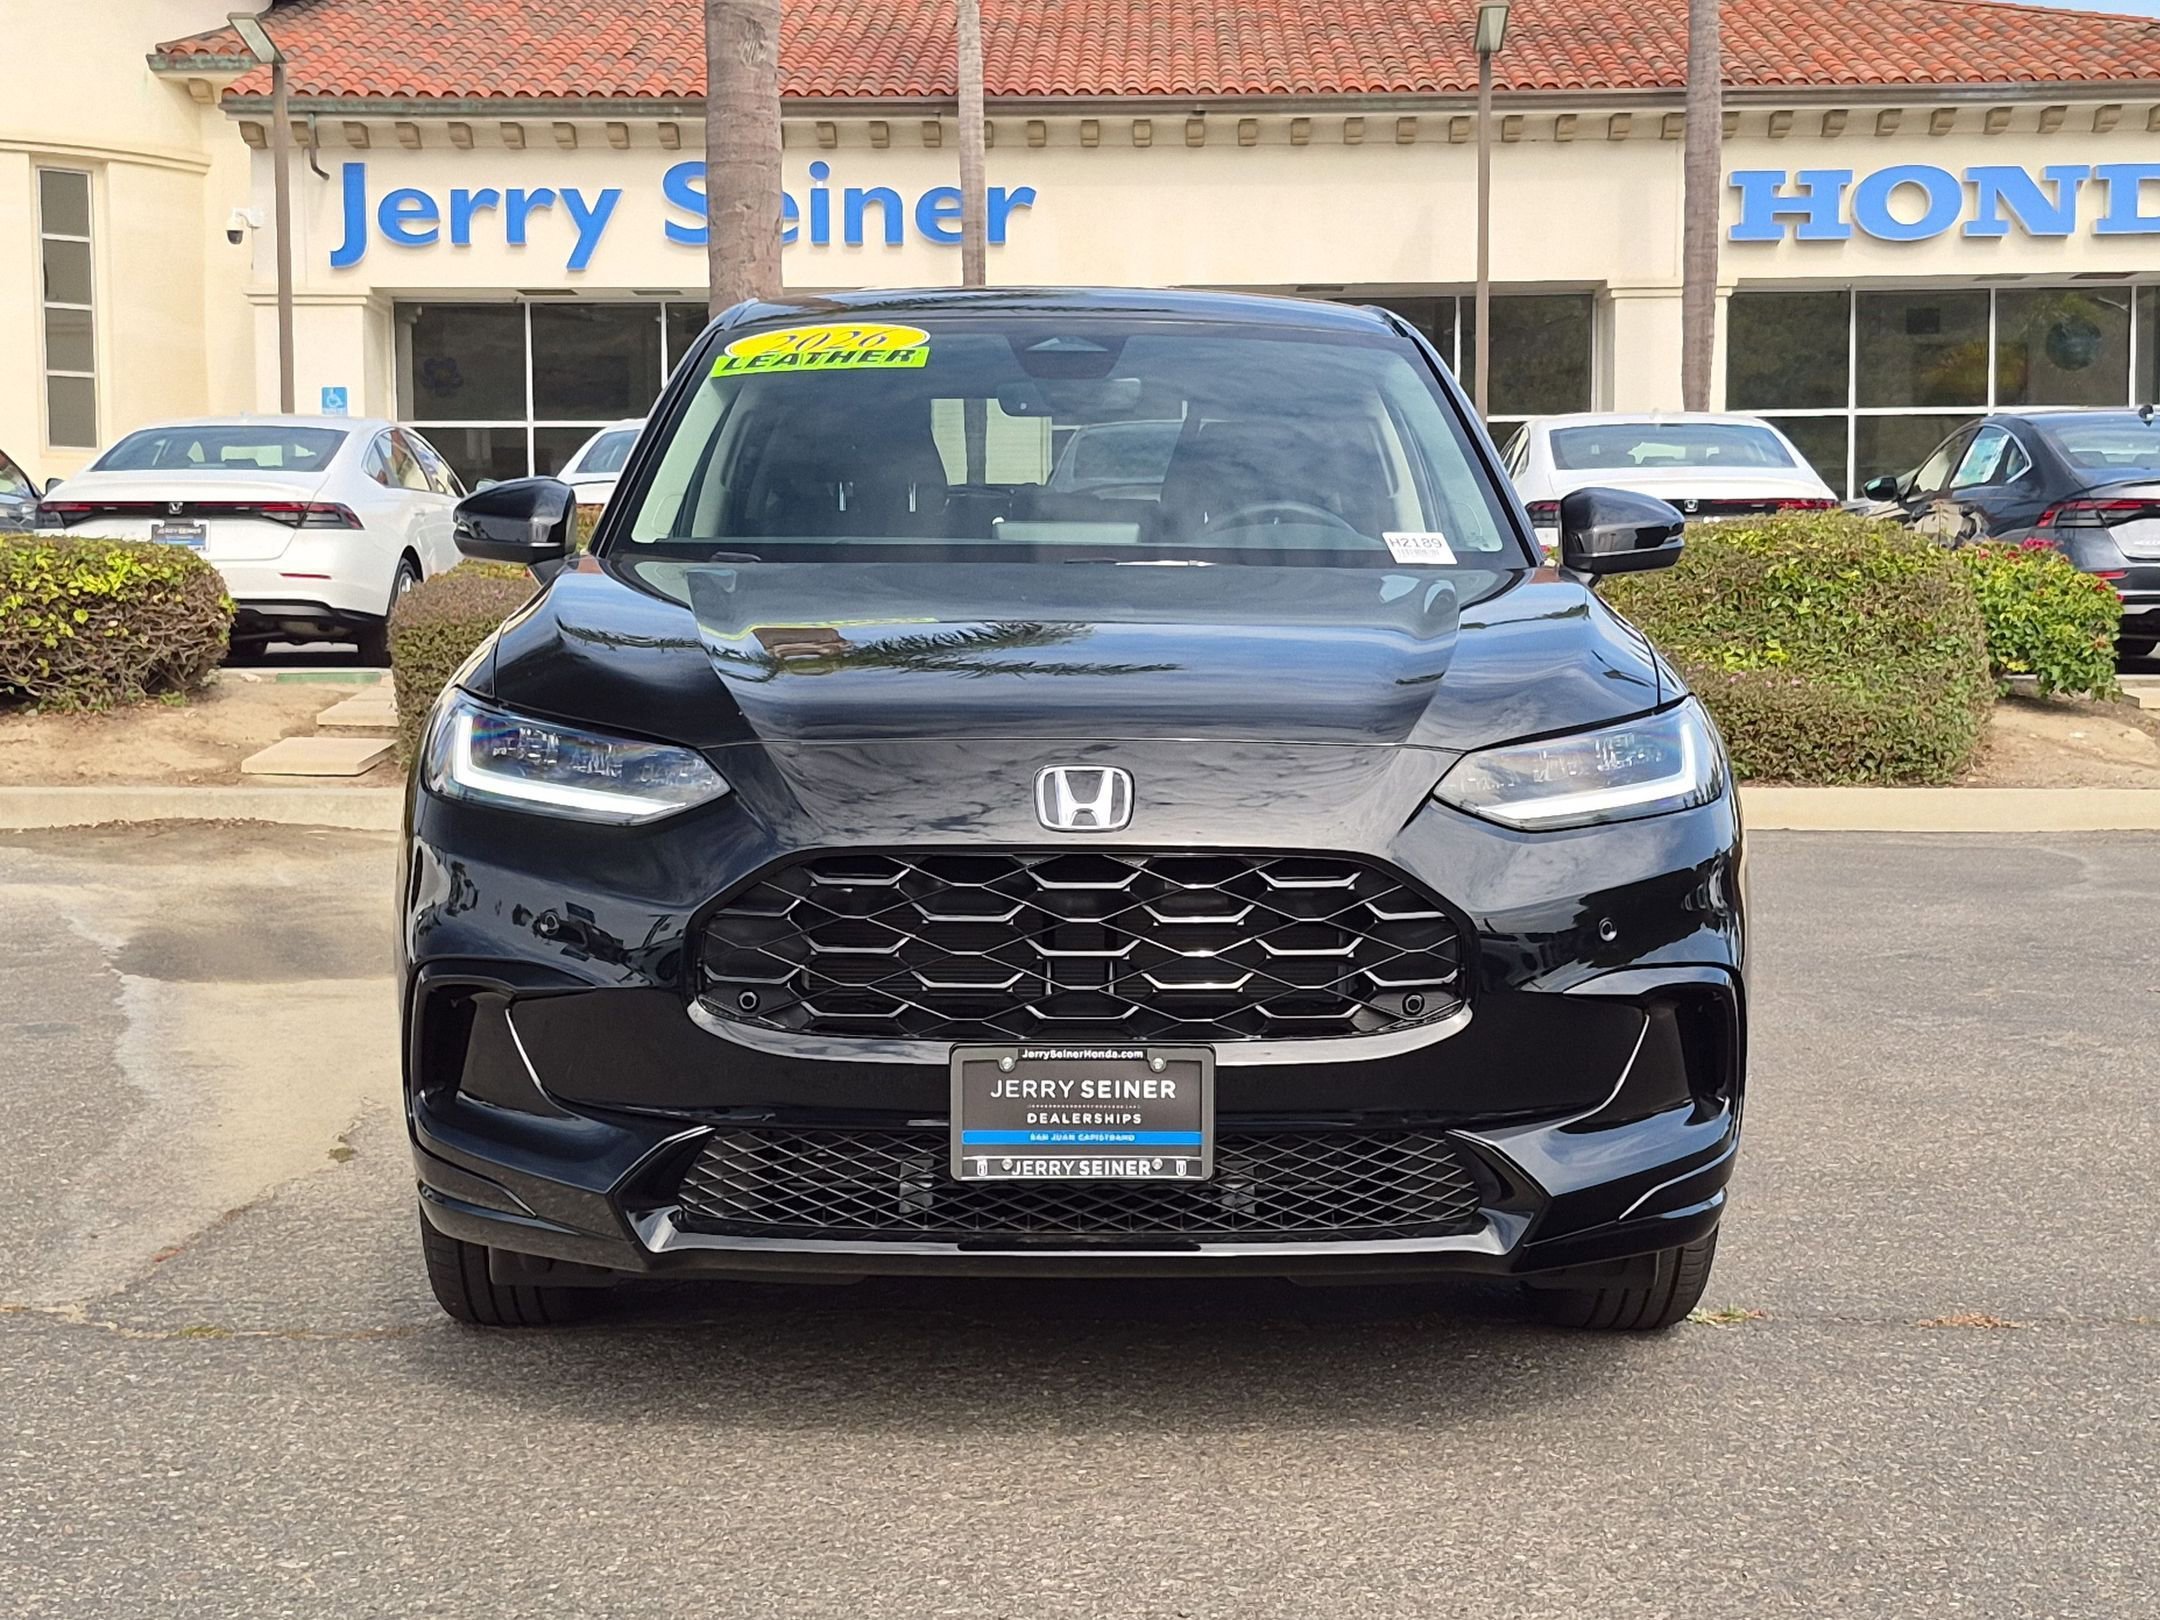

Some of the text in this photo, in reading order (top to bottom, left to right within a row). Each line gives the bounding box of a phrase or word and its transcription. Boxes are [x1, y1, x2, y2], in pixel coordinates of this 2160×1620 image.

[330, 160, 1037, 272] Jerry Siner
[764, 330, 895, 352] 2026
[722, 349, 916, 371] LEATHER
[1388, 537, 1443, 549] H2189
[1021, 1049, 1144, 1060] JerrySeinerHonda.com
[990, 1080, 1177, 1099] JERRY SEINER
[1027, 1113, 1142, 1125] DEALERSHIPS
[1051, 1132, 1076, 1142] JUAN
[1011, 1160, 1151, 1176] JERRY SEINER
